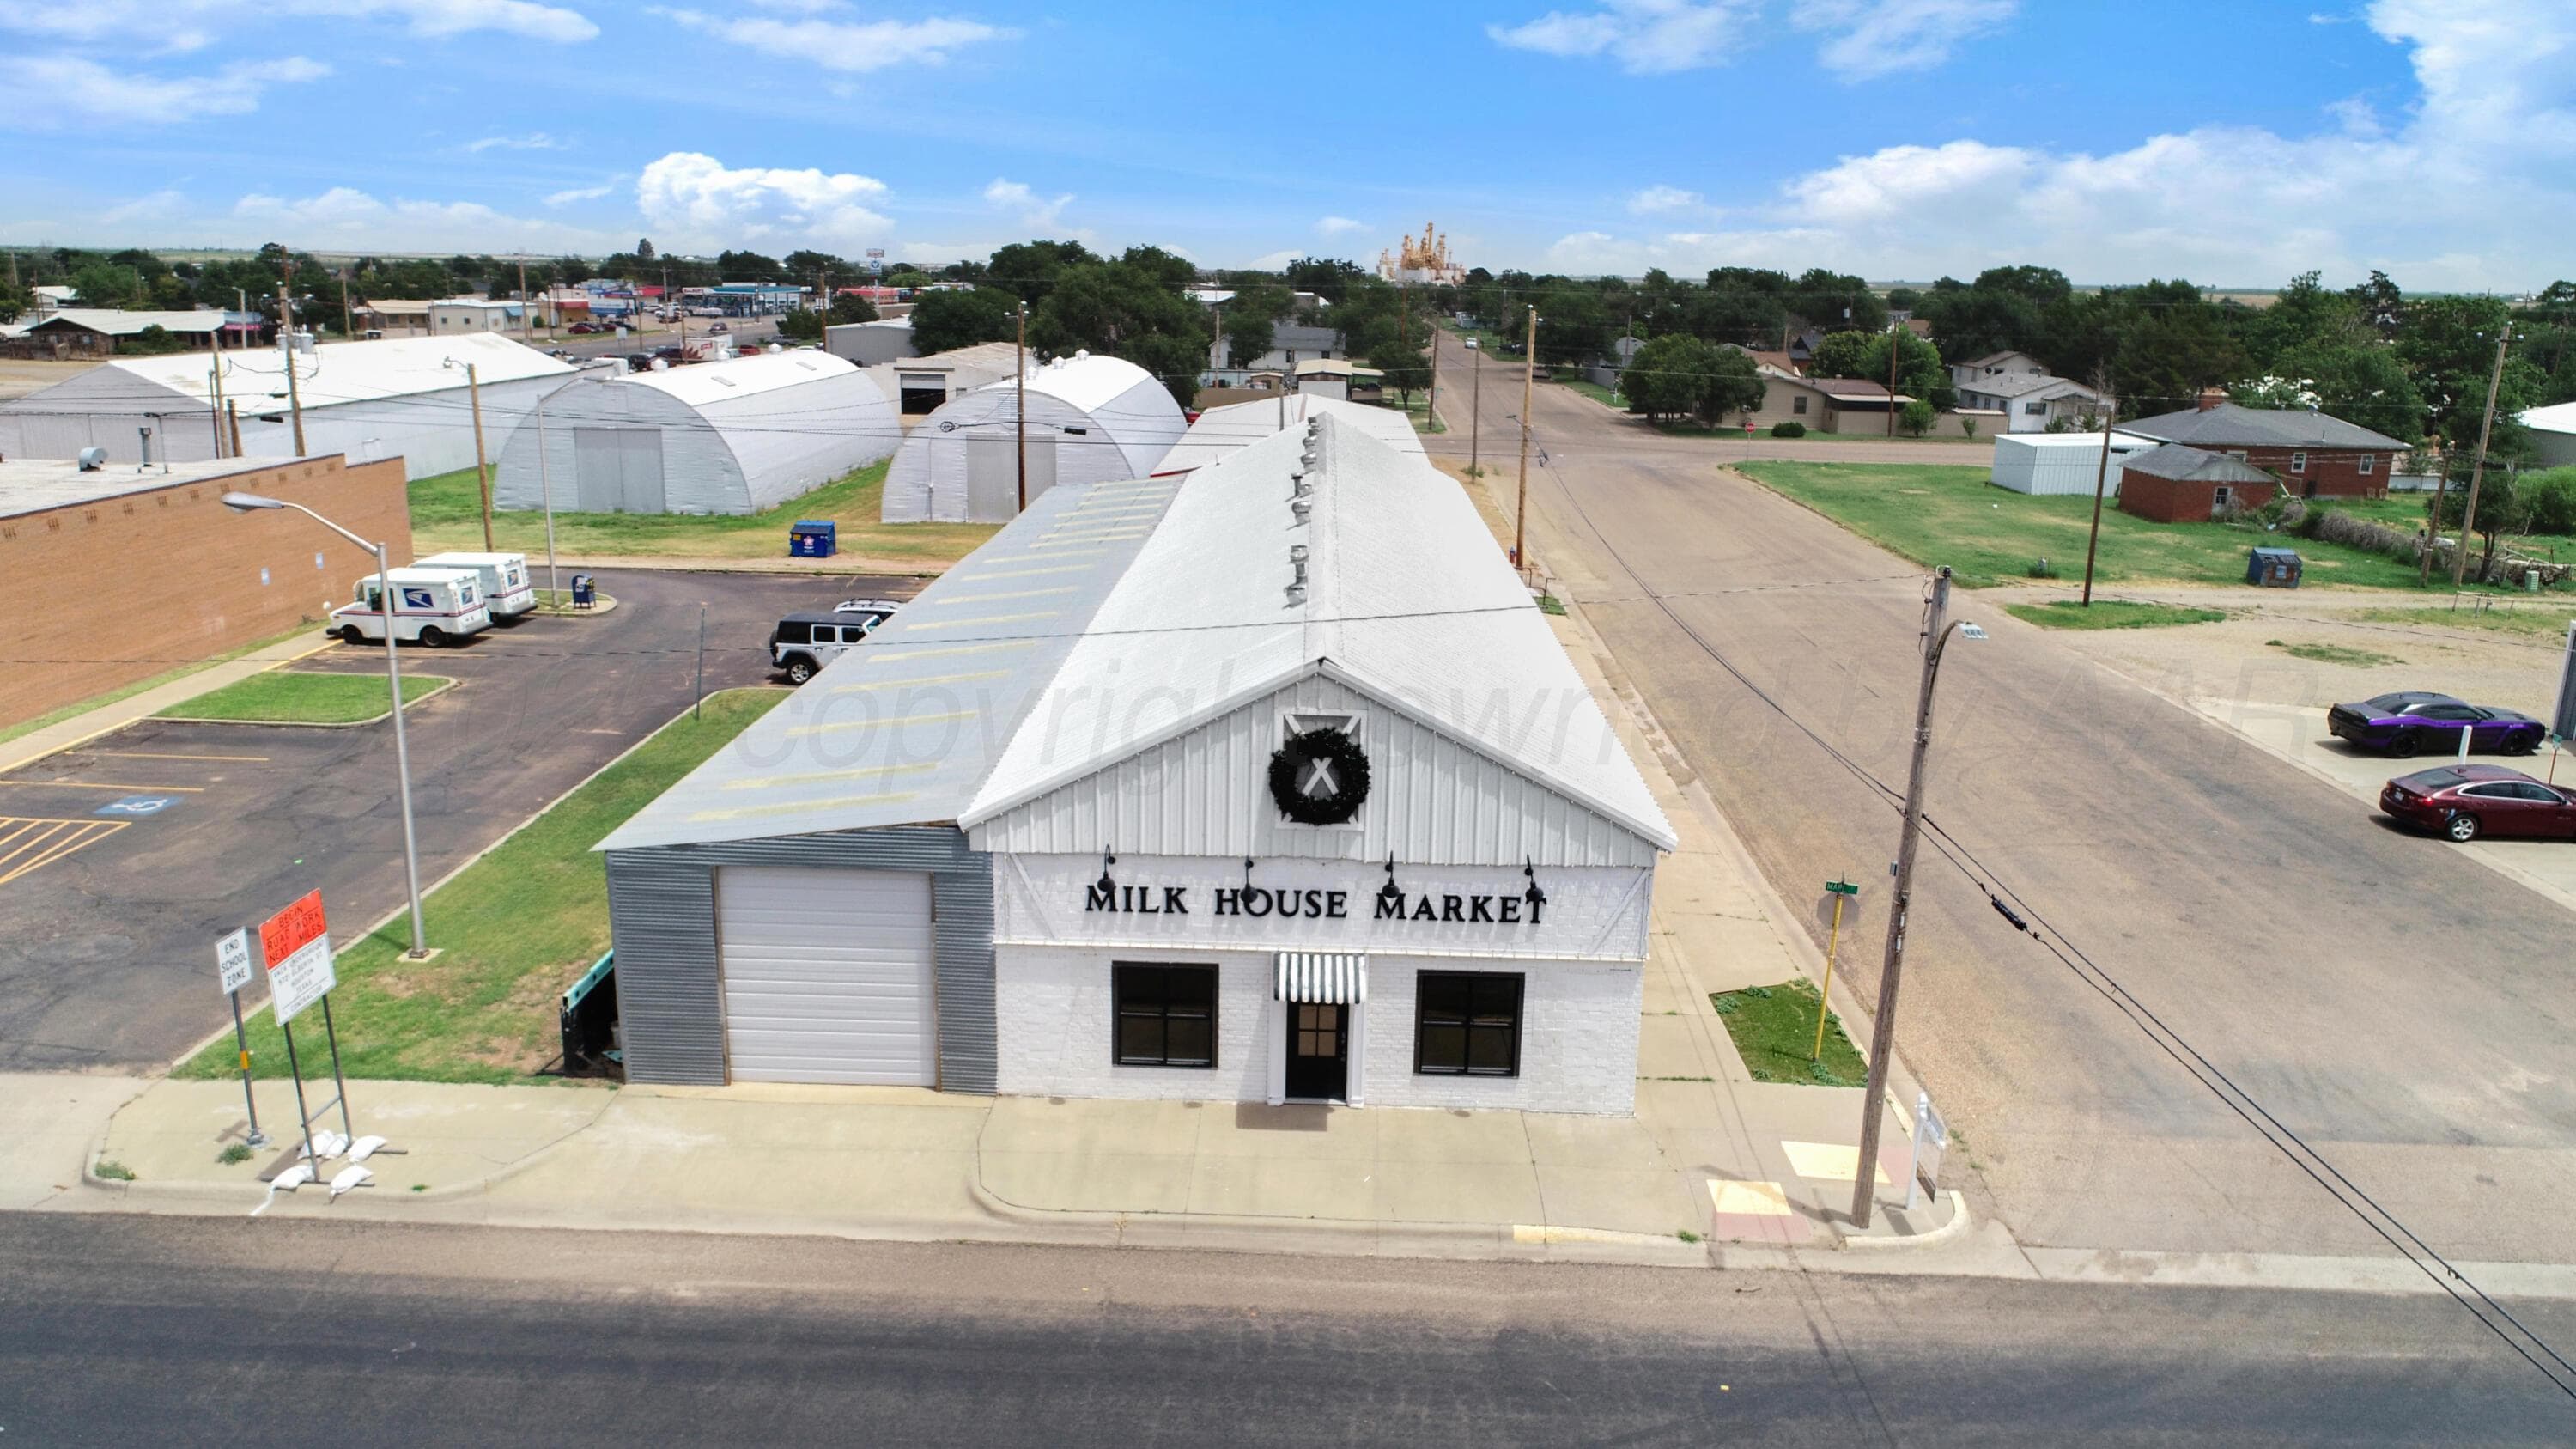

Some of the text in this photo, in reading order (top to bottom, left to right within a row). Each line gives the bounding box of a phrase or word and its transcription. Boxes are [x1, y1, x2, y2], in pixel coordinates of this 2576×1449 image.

[278, 904, 302, 928] BEGIN
[1085, 885, 1546, 924] MILK HOUSE MARKET
[225, 939, 240, 954] END
[268, 928, 289, 952] ROAD
[269, 923, 323, 963] NEXT MILES
[222, 951, 247, 973] SCHOOL
[228, 967, 246, 987] ZONE
